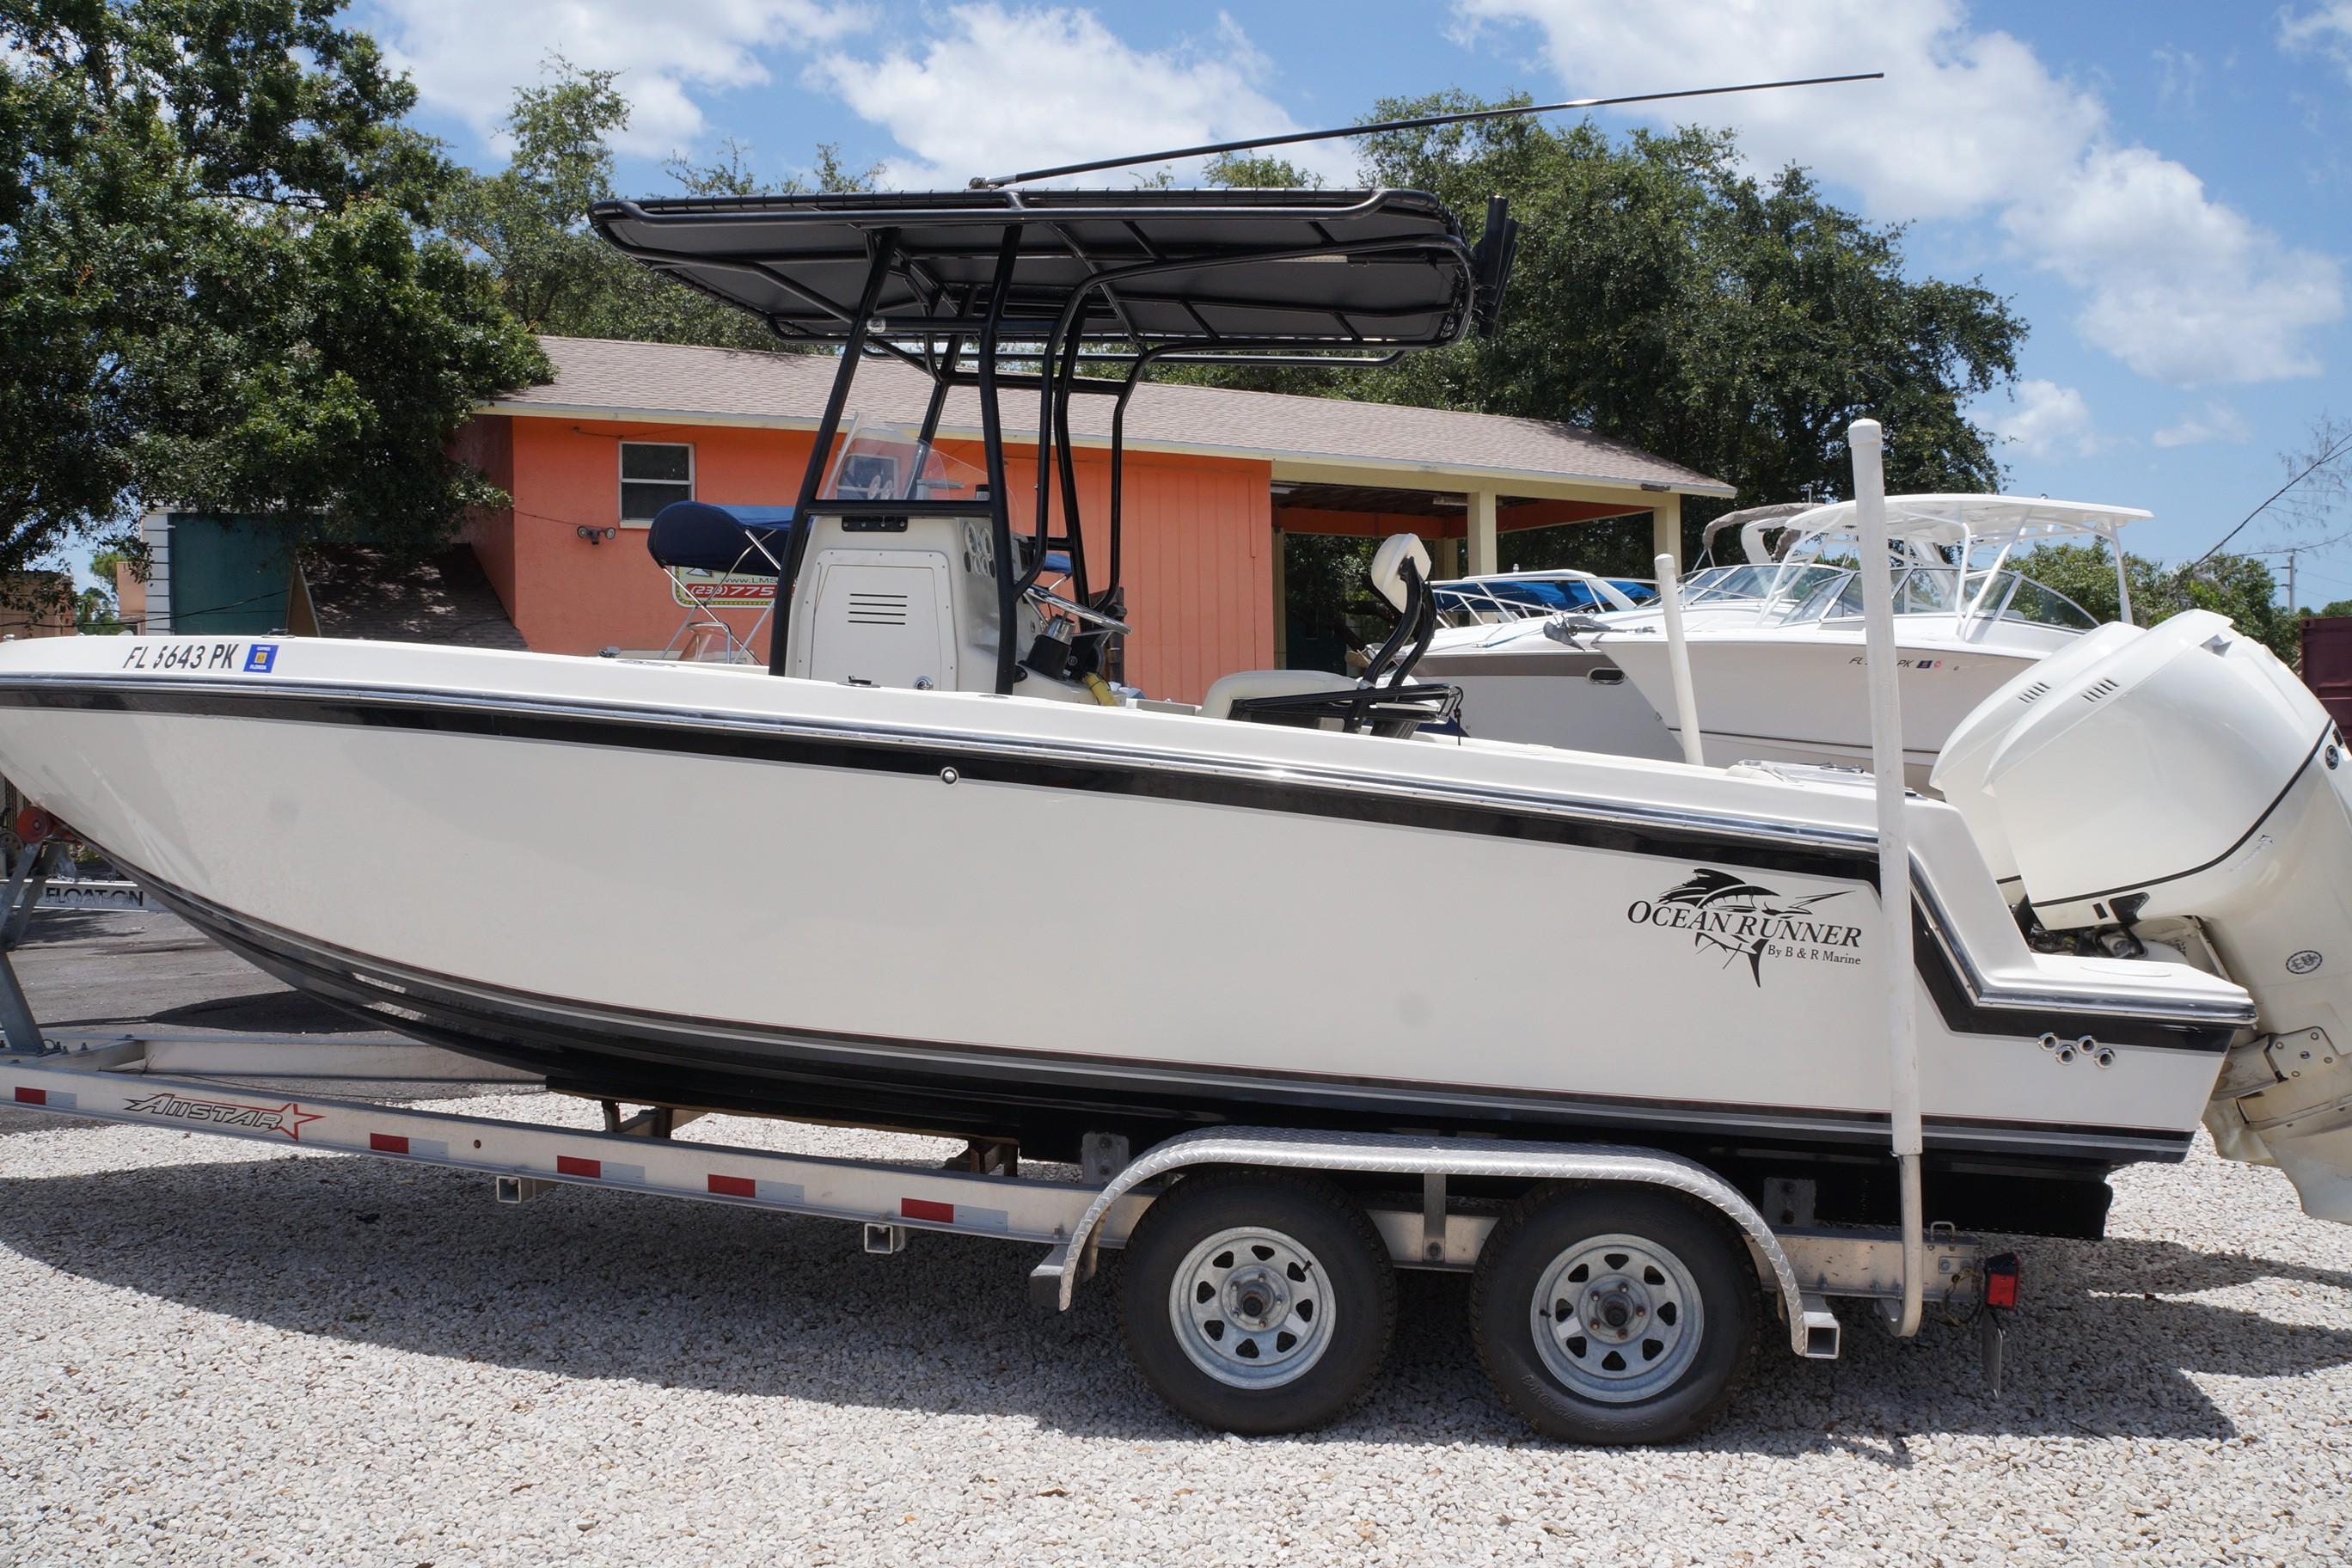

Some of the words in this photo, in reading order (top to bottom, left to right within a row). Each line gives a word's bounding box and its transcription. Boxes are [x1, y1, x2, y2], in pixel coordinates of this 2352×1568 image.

[122, 646, 149, 669] FL
[153, 645, 205, 669] 5643
[208, 644, 240, 669] PK
[1849, 657, 1864, 665] FL
[1627, 900, 1732, 934] OCEAN
[1735, 916, 1863, 947] RUNNER
[1767, 945, 1783, 958] By
[1785, 946, 1794, 958] B
[1797, 947, 1807, 959] &
[1810, 949, 1820, 960] R
[1822, 951, 1861, 965] Marine
